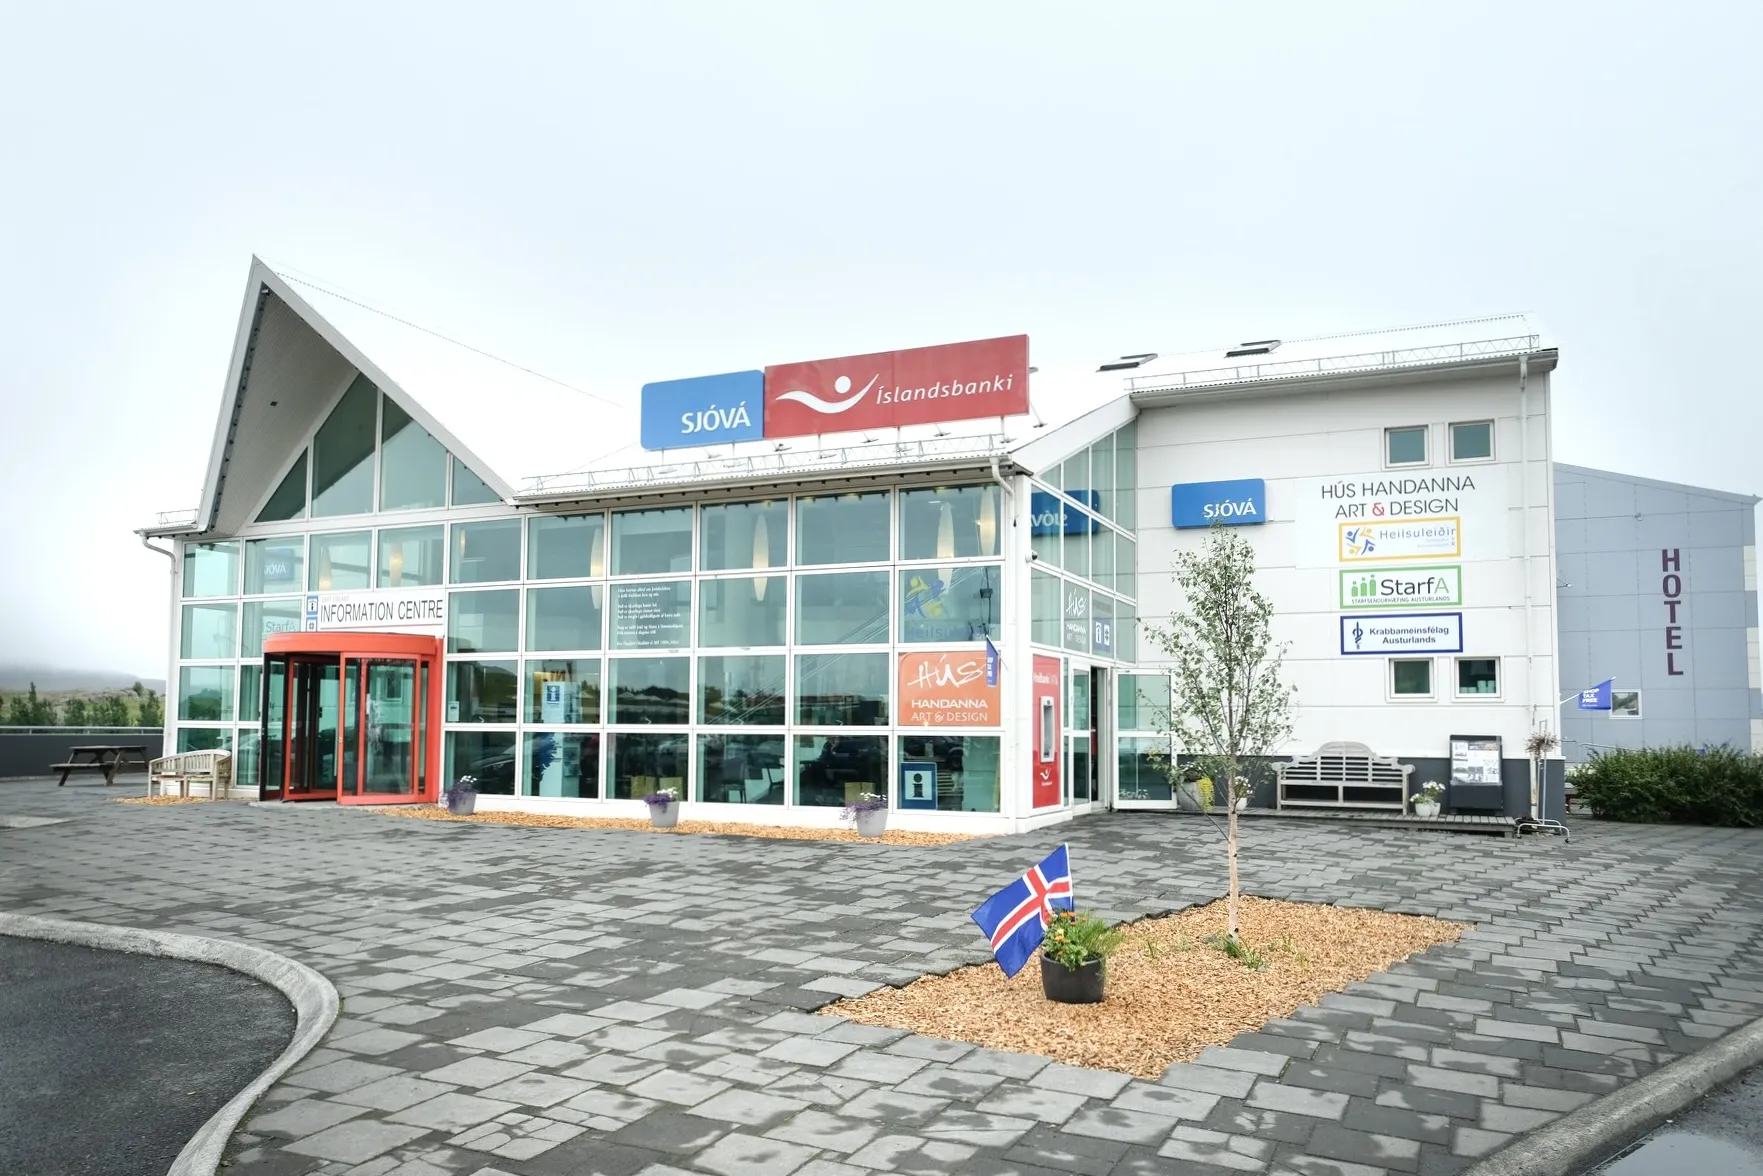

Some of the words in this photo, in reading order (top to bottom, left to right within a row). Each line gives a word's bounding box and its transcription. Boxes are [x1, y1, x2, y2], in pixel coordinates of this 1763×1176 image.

[877, 373, 1013, 405] Íslandsbanki
[681, 401, 752, 434] SJÓVÁ
[1322, 480, 1356, 499] HÚS
[1363, 476, 1476, 496] HANDANNA
[1203, 498, 1257, 518] SJÓVÁ
[1335, 503, 1367, 518] ART
[1372, 502, 1385, 517] &
[1390, 498, 1459, 516] DESIGN
[1379, 526, 1457, 539] Heilsuleiðir
[1380, 576, 1449, 596] StarfA
[320, 602, 394, 623] INFORMATION
[398, 599, 443, 620] CENTRE
[1662, 548, 1684, 675] HOTEL
[1369, 626, 1450, 636] Krabbameinsfélag
[1382, 636, 1436, 645] Austurlands
[911, 699, 988, 709] HANDANNA
[911, 712, 932, 721] ART
[946, 712, 988, 722] DESIGN
